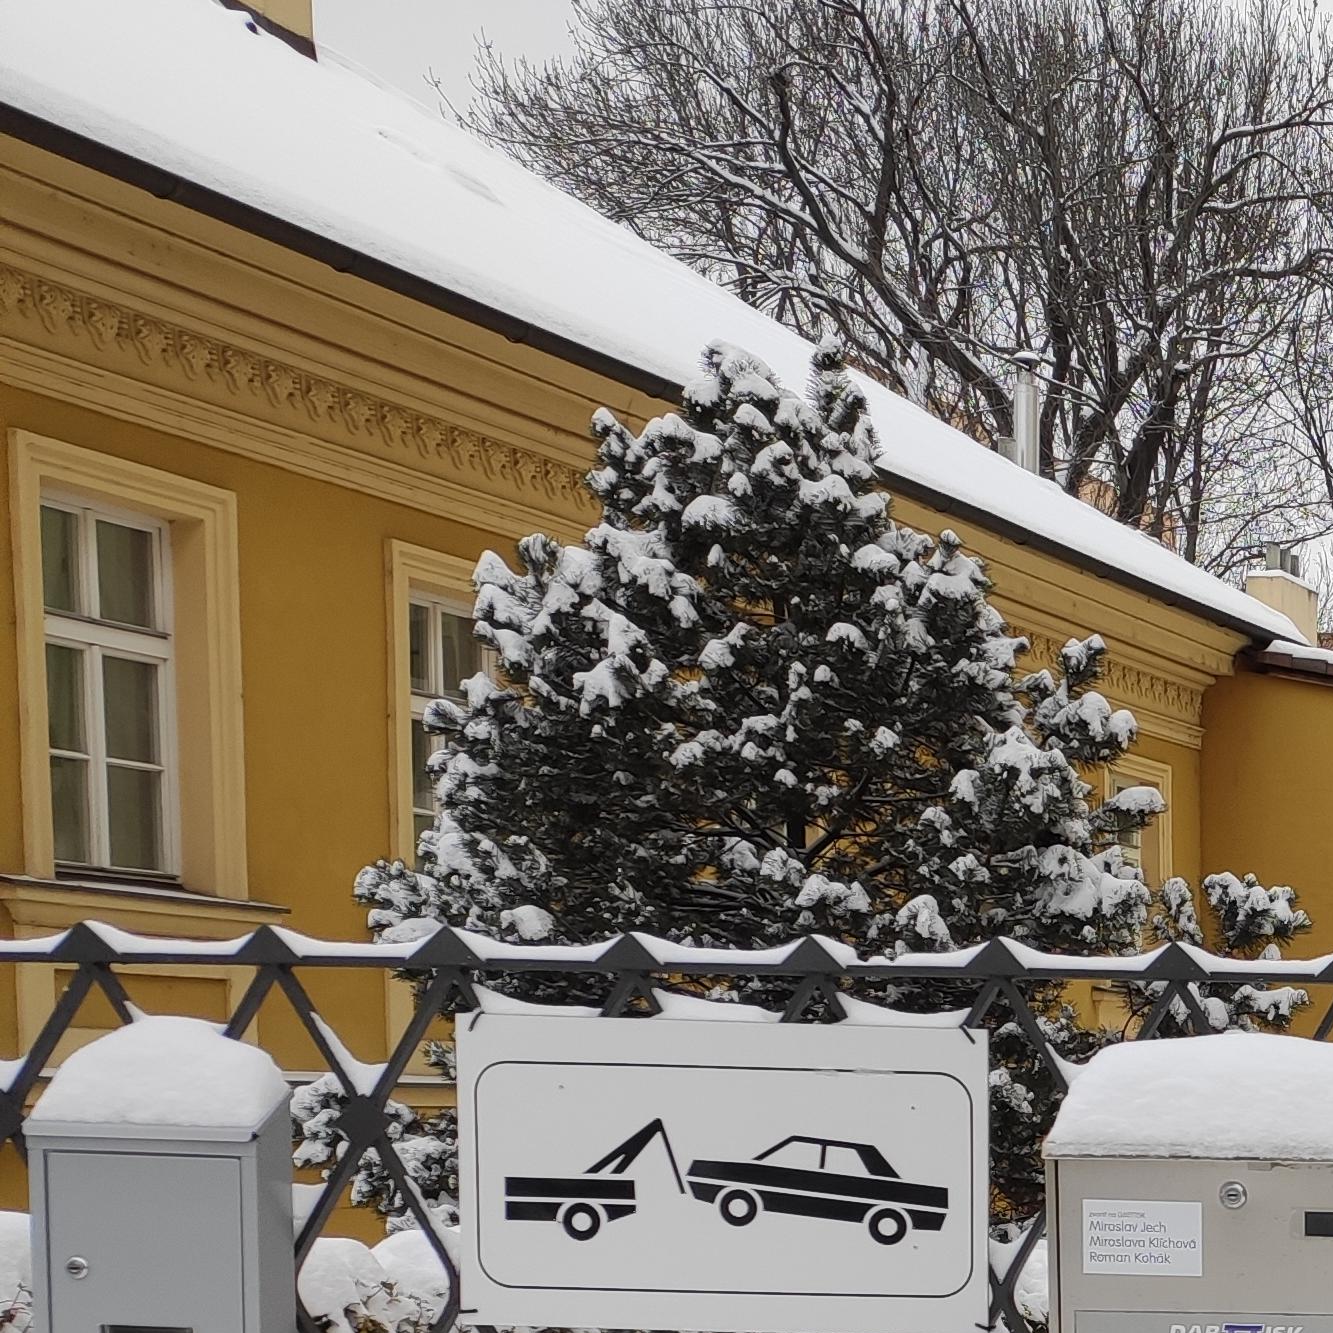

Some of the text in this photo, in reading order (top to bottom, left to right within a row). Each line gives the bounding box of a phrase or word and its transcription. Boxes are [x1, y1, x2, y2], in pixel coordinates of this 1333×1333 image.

[1089, 1221, 1166, 1233] Miroslav Jech
[1089, 1252, 1130, 1262] Roman
